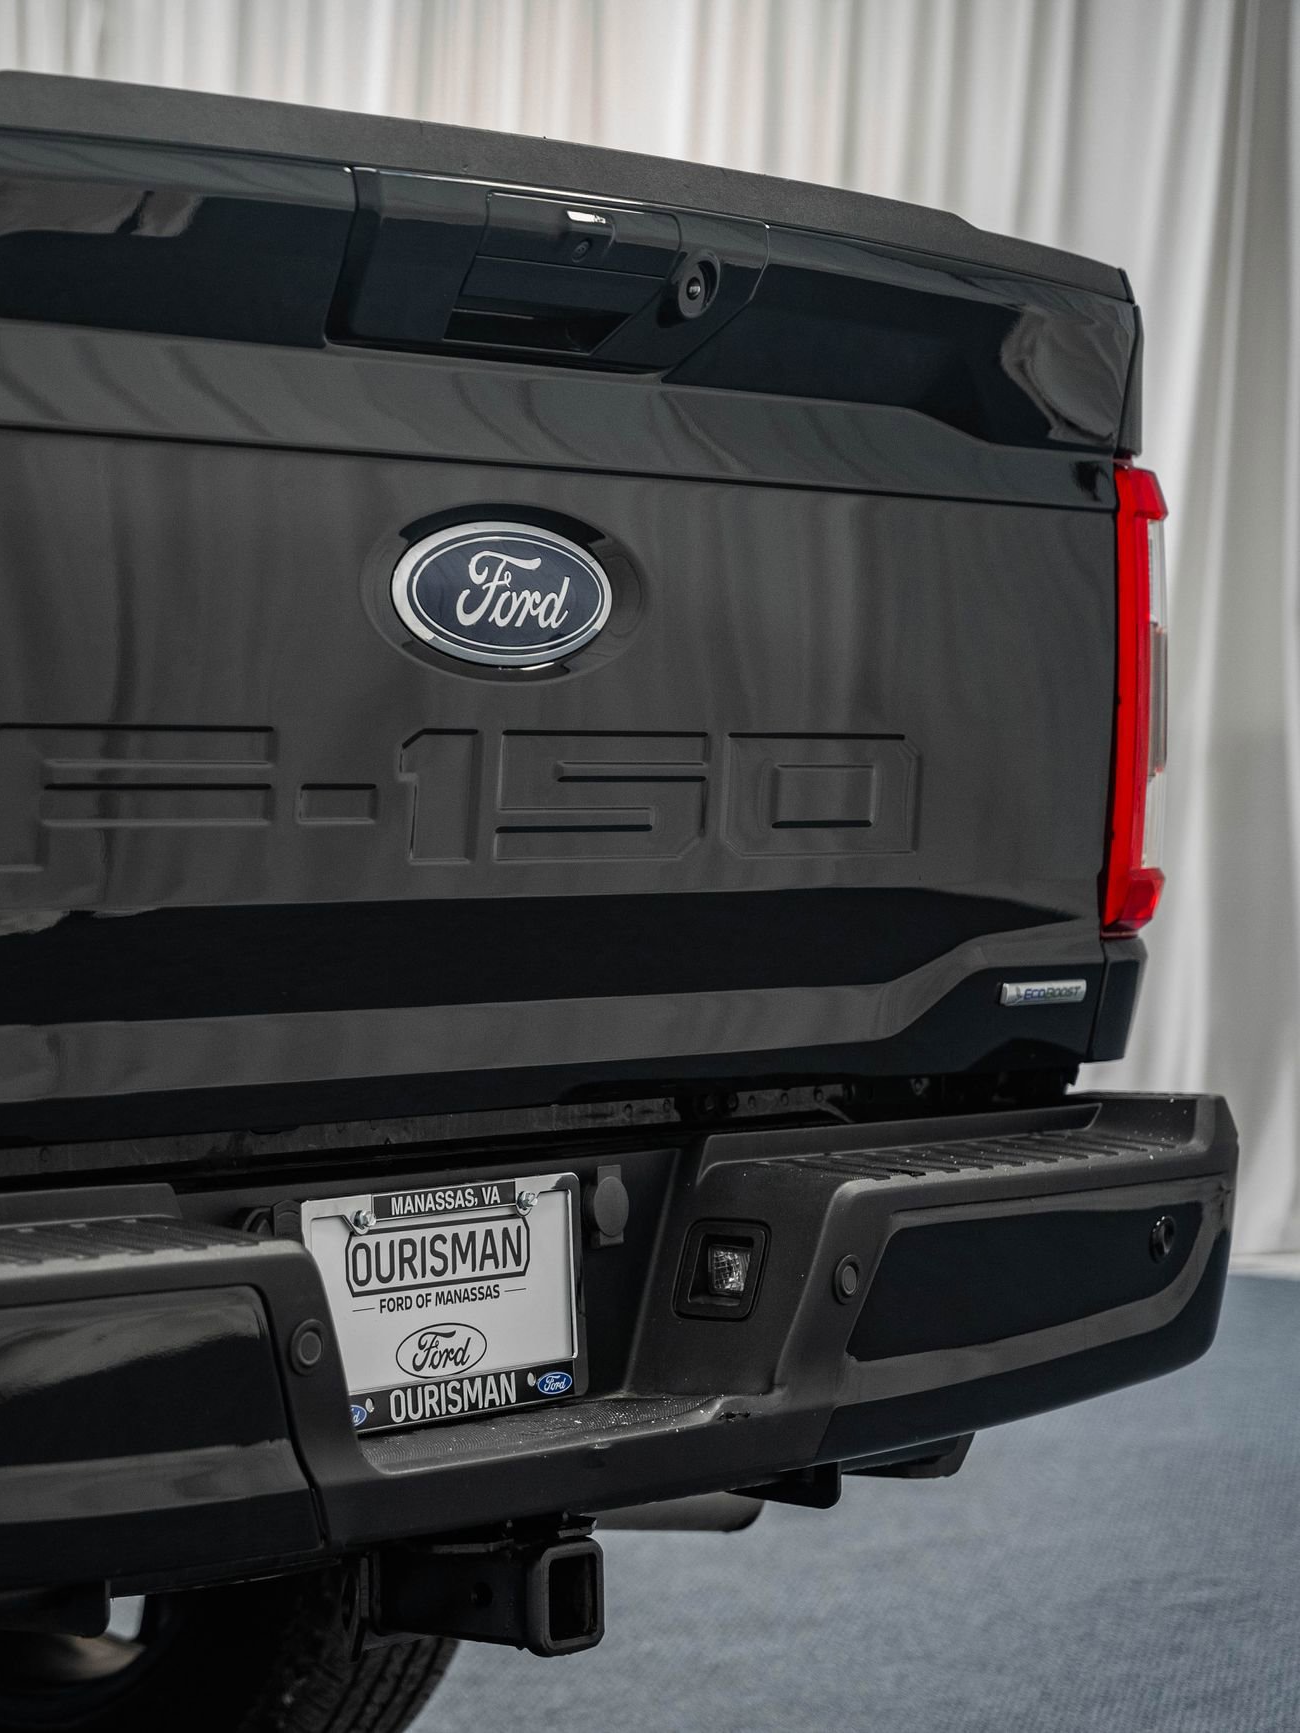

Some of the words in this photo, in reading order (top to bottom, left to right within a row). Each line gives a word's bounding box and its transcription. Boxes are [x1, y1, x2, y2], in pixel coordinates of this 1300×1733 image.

[455, 550, 570, 629] Ford
[390, 1188, 478, 1216] MANASSAS,
[481, 1186, 501, 1205] VA
[351, 1225, 523, 1287] OURISMAN
[379, 1295, 413, 1314] FORD
[416, 1292, 432, 1310] OF
[434, 1284, 501, 1307] MANASSAS
[411, 1330, 472, 1372] Ford
[389, 1371, 517, 1423] OURISMAN
[543, 1374, 567, 1392] Ford
